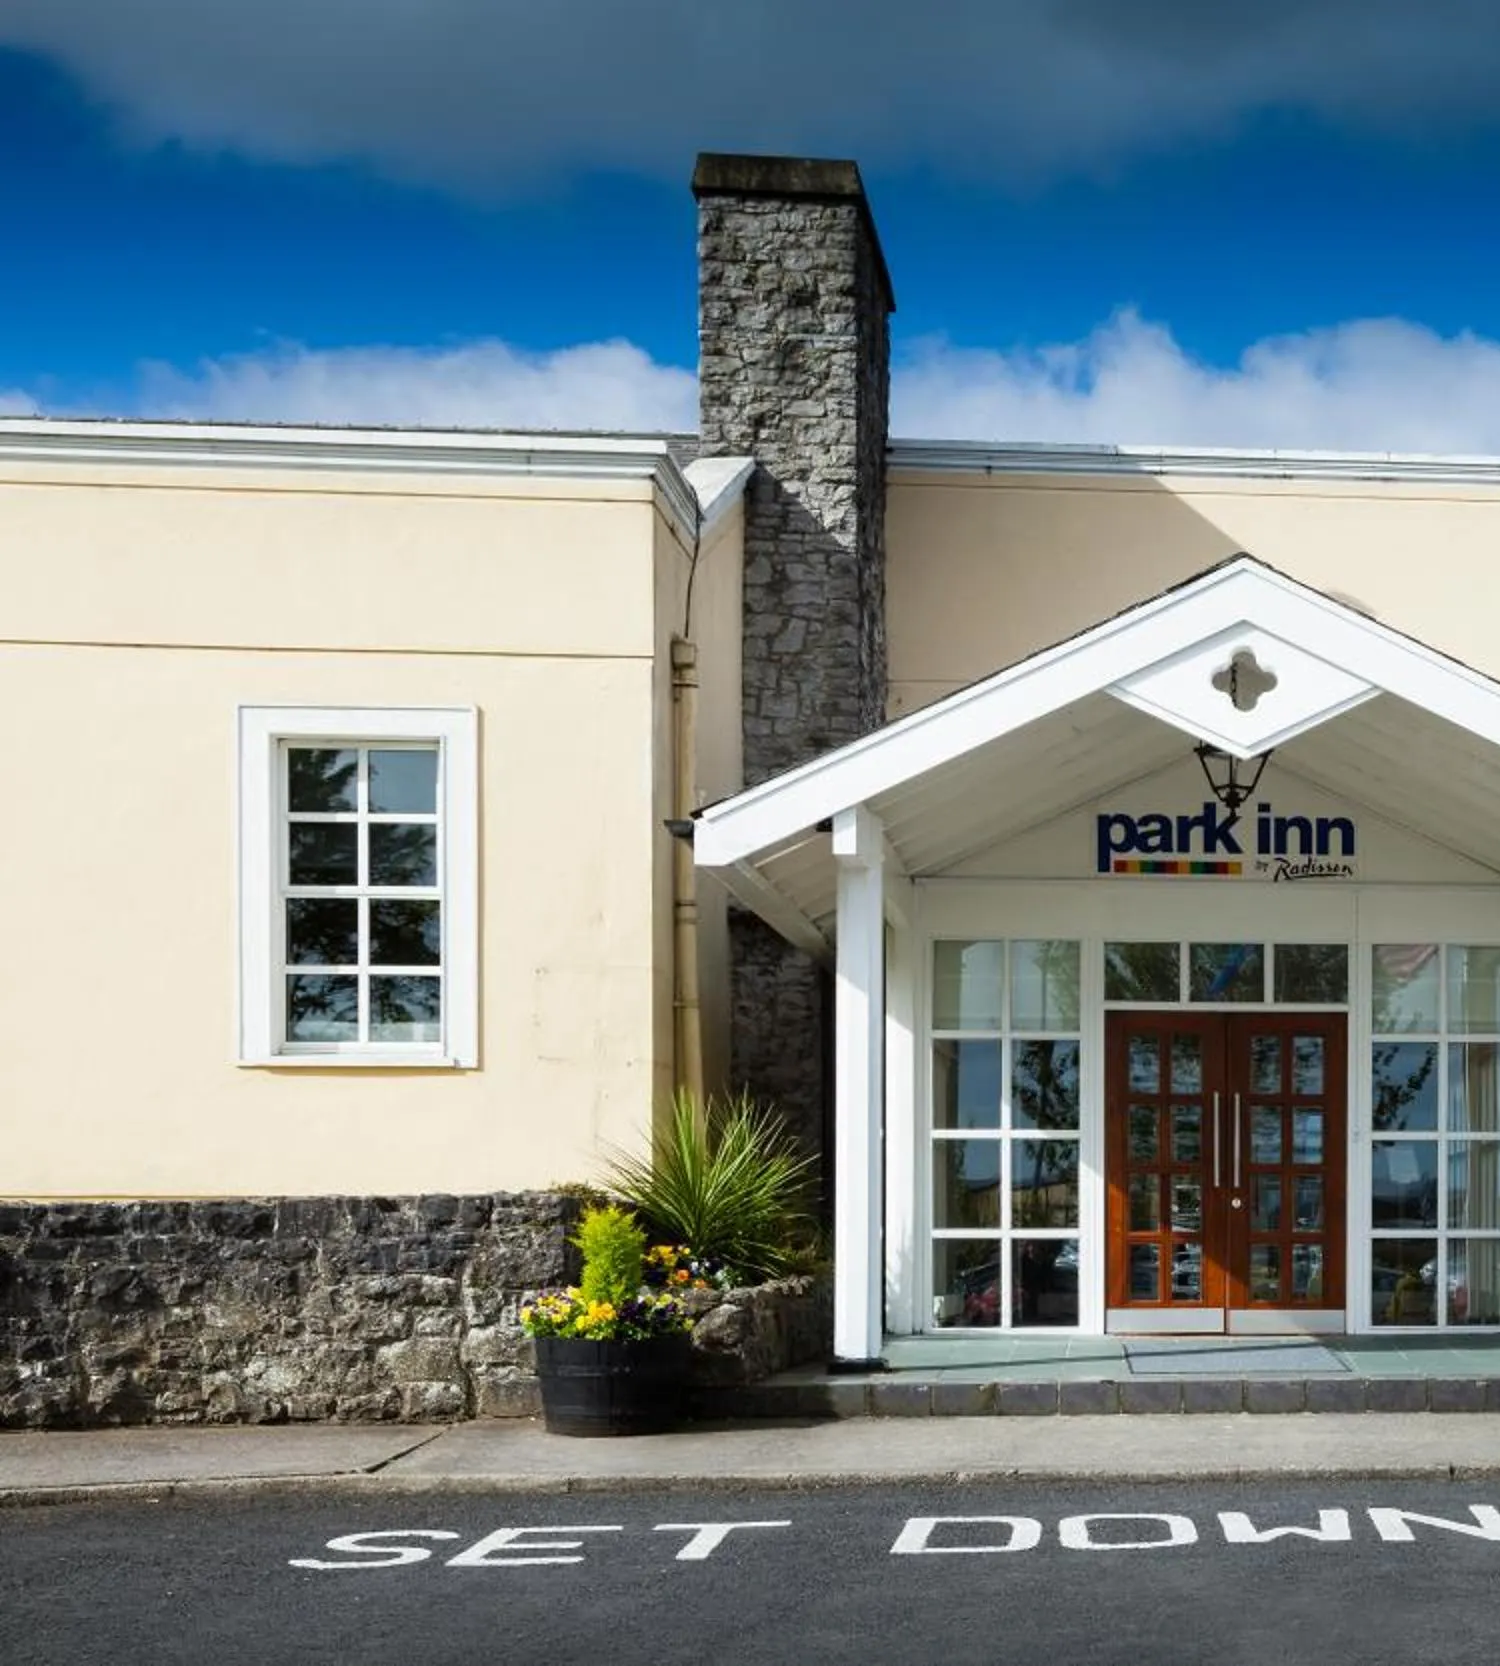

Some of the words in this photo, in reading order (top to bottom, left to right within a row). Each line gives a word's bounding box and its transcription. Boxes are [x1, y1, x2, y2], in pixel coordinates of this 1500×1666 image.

[1097, 802, 1243, 873] park
[1257, 803, 1355, 855] inn
[1273, 857, 1353, 882] Radisson
[288, 1520, 793, 1569] SET
